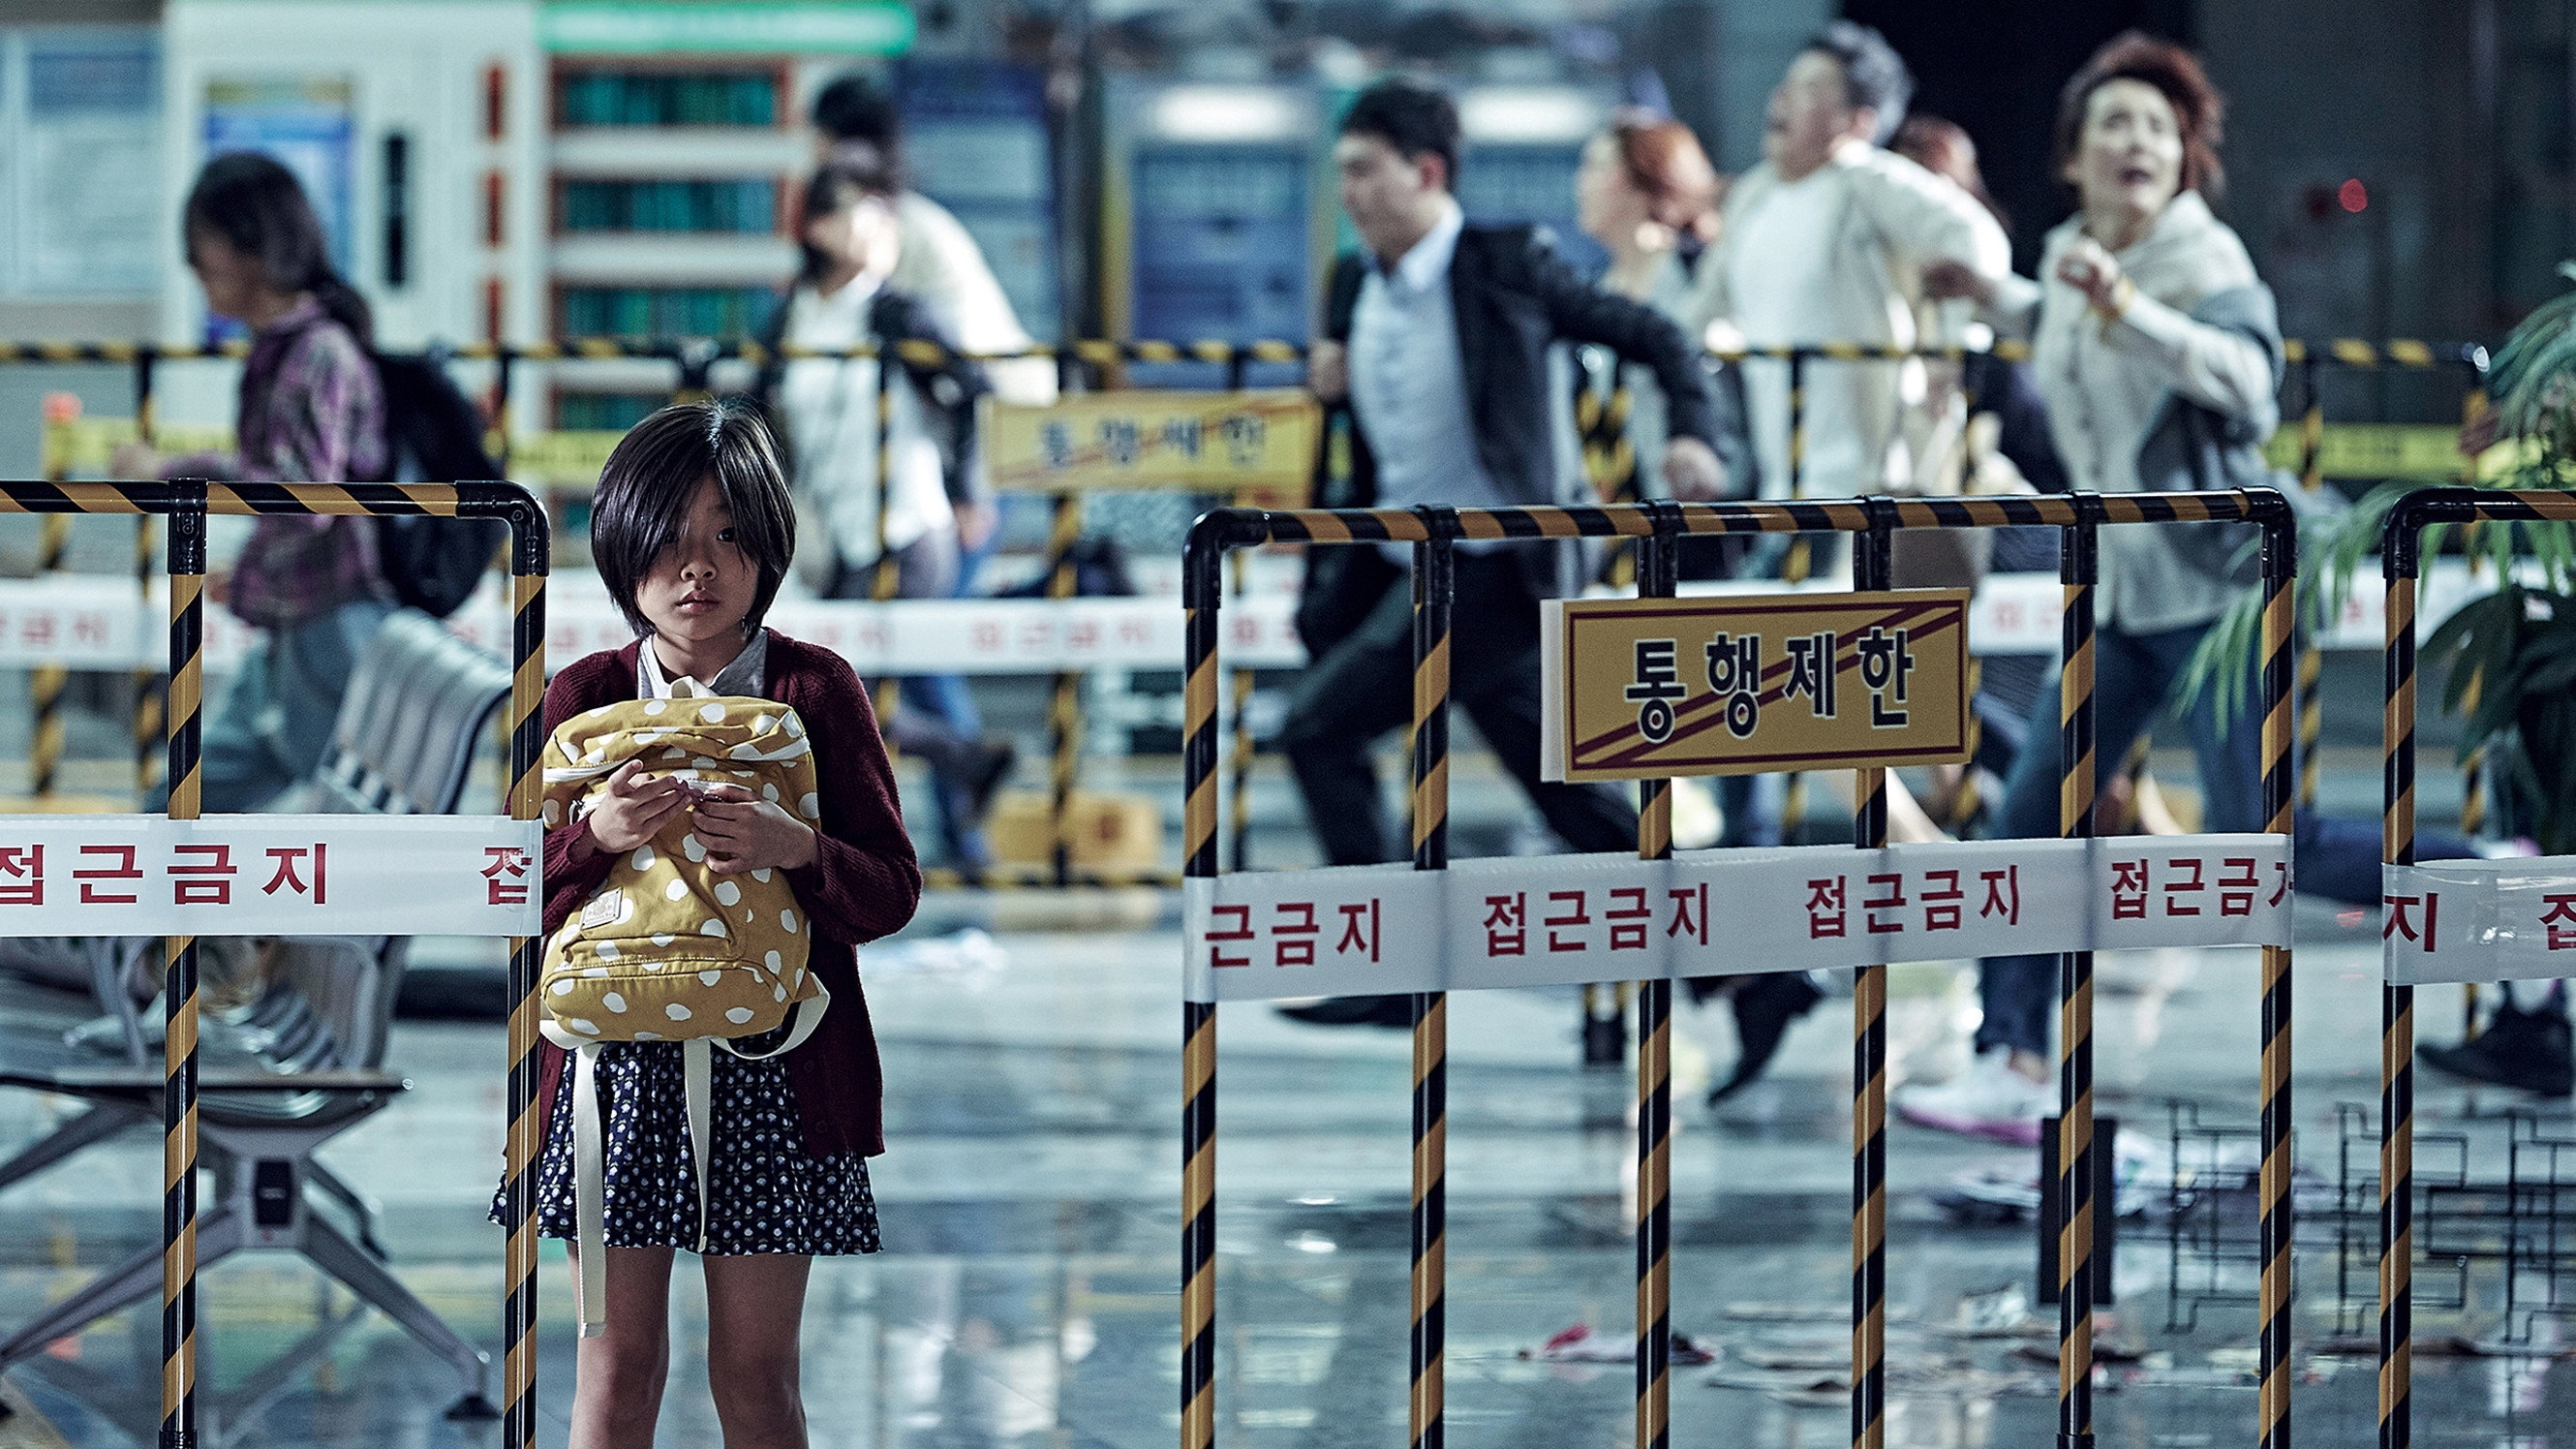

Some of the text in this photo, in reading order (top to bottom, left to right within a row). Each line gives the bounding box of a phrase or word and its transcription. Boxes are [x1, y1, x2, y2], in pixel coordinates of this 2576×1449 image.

[1624, 627, 1914, 743] 통행제한
[1205, 898, 1381, 968] 근금지
[1484, 881, 1710, 958] 접근금지
[1805, 865, 2020, 940] 접근금지
